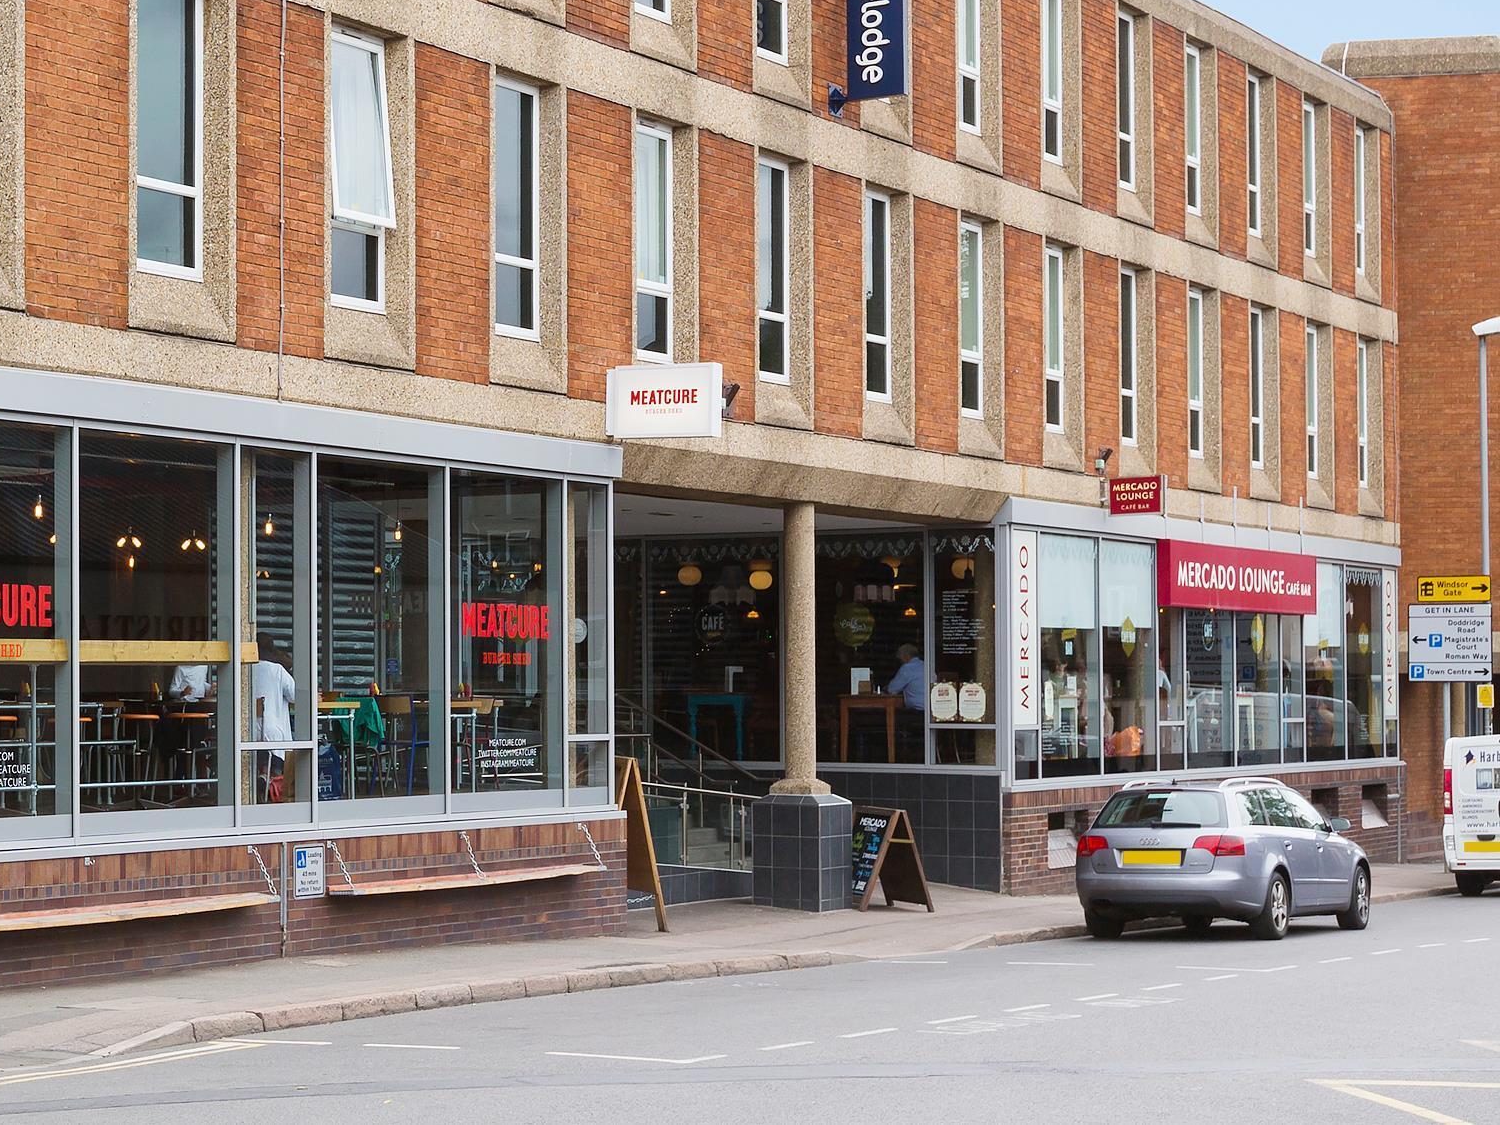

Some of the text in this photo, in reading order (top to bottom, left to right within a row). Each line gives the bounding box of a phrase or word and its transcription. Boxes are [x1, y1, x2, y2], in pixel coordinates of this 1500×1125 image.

[630, 388, 698, 406] MEATCURE
[1112, 481, 1158, 492] MERCADO
[1116, 491, 1155, 501] LOUNGE
[1178, 560, 1312, 597] MERCADO LOUNGE CAFÉ BAR
[1425, 606, 1441, 614] GET
[1453, 606, 1475, 614] LANE
[461, 602, 550, 640] MEATCURE
[1020, 545, 1029, 709] MERCADO
[1457, 626, 1476, 634] Road
[482, 652, 512, 665] BURGER
[1472, 653, 1488, 661] Way
[488, 738, 527, 747] MEATCURE.COM
[859, 817, 887, 829] MERCADO
